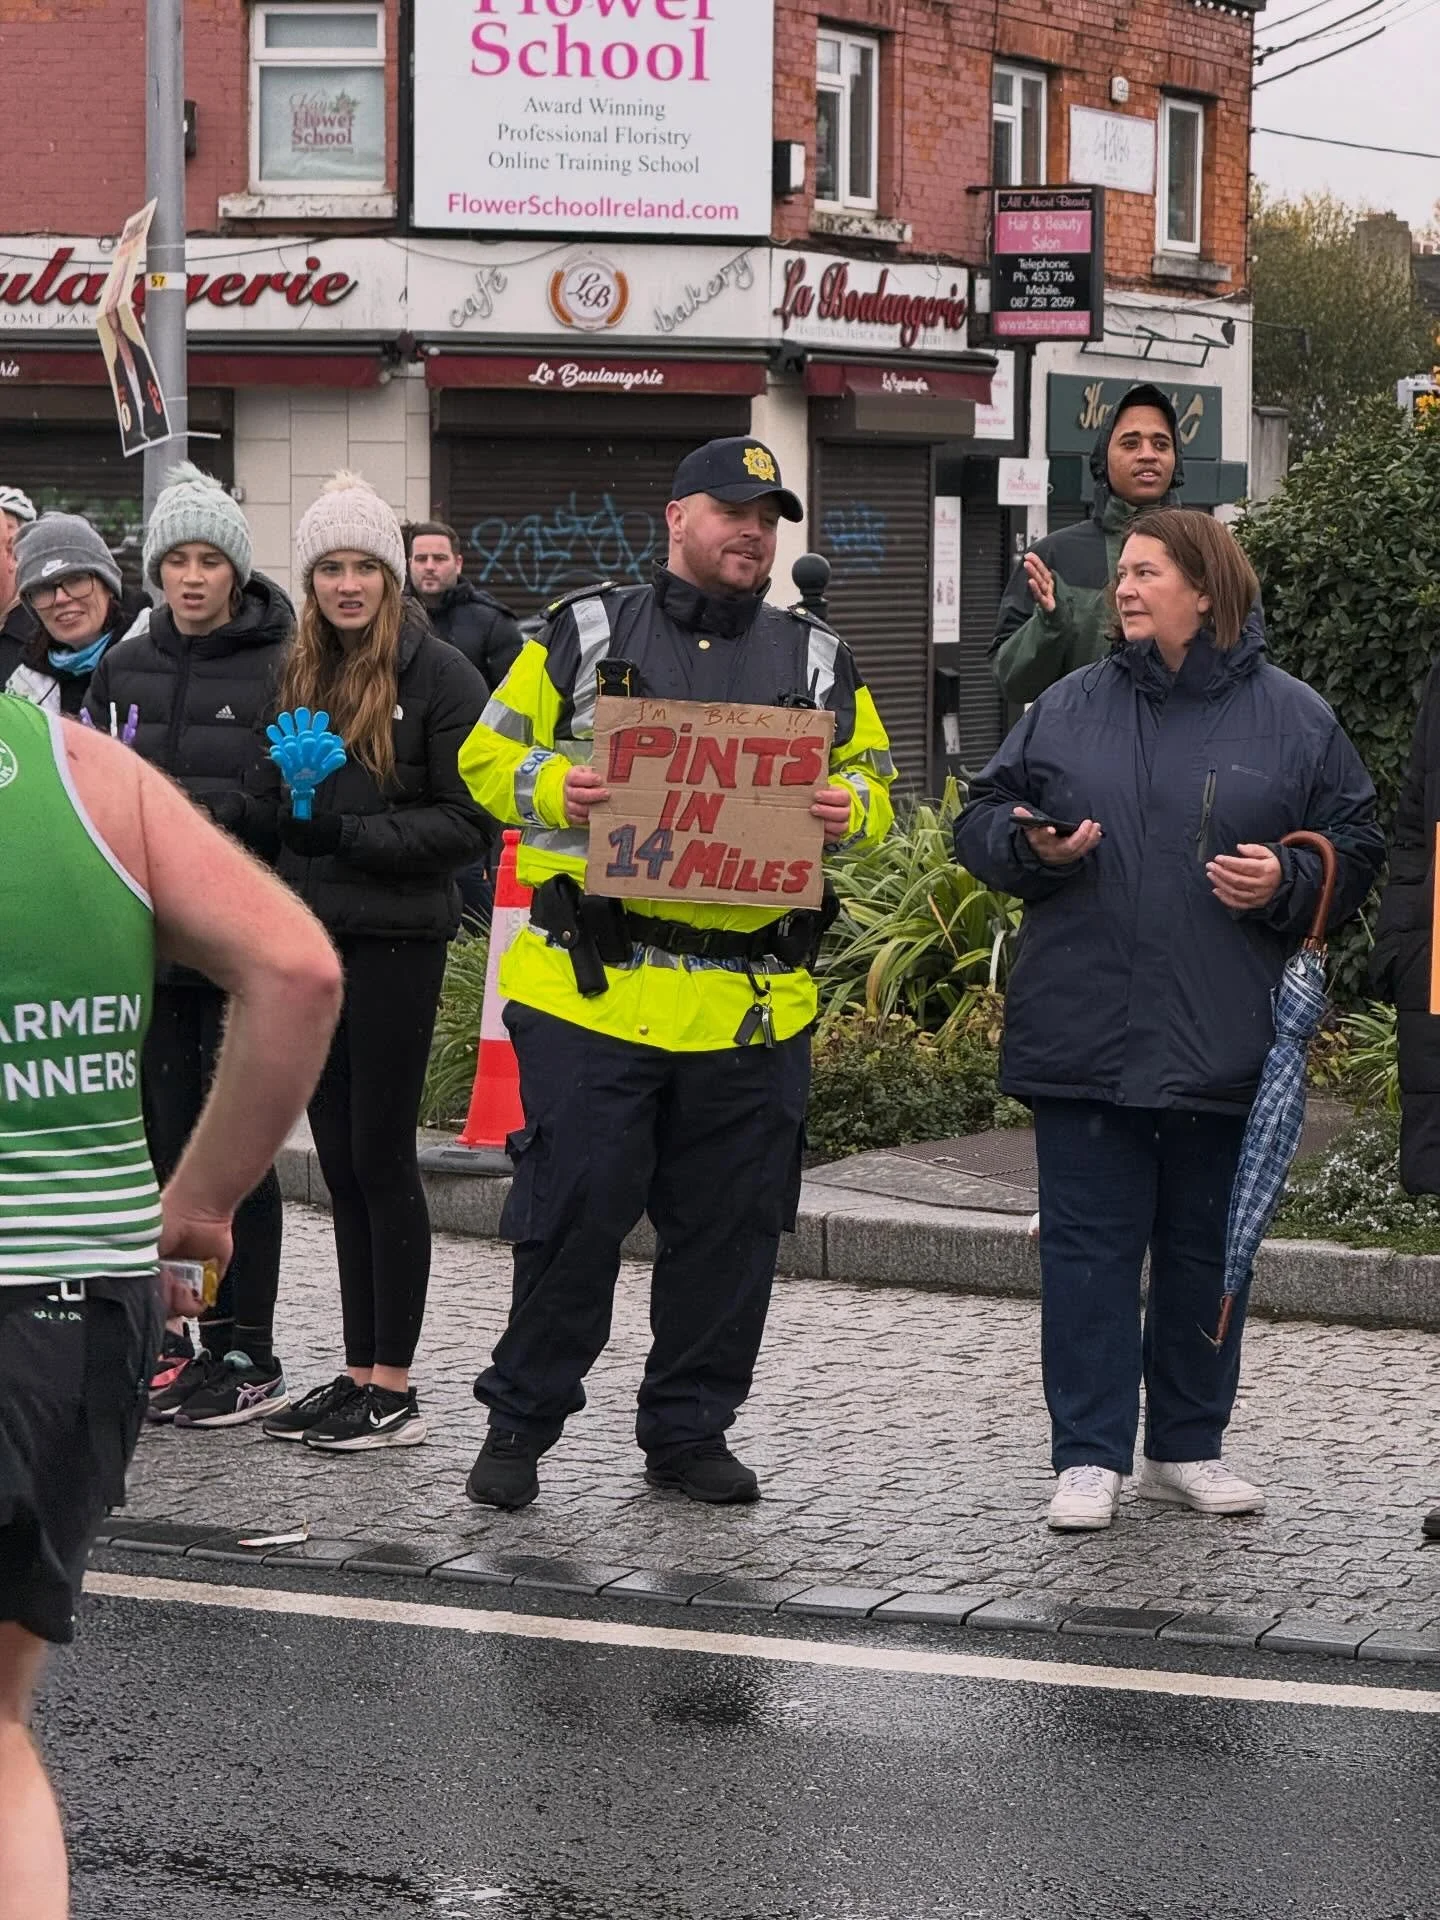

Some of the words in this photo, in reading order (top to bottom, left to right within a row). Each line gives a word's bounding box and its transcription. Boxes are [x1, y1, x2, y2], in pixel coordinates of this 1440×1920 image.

[470, 21, 711, 81] School
[524, 97, 583, 114] Award
[589, 98, 666, 120] Winning
[292, 127, 352, 145] School
[498, 123, 608, 143] Professional
[615, 126, 692, 149] Floristry
[488, 151, 550, 170] Online
[556, 153, 632, 176] Training
[638, 155, 700, 173] School
[448, 193, 739, 220] FlowerSchoolIreland.com
[1001, 196, 1022, 208] All
[1024, 195, 1054, 208] About
[1056, 195, 1090, 209] Beauty
[1008, 215, 1028, 231] Hair
[1032, 215, 1041, 231] &
[1045, 215, 1083, 233] Beauty
[1032, 235, 1061, 250] Salon
[151, 275, 166, 287] 57
[1031, 271, 1050, 282] 453
[1053, 271, 1075, 282] 7316
[450, 265, 508, 328] café
[654, 252, 755, 333] bakery
[773, 258, 816, 331] La
[1010, 297, 1029, 309] 087
[57, 313, 91, 324] BAK
[529, 362, 555, 386] La
[558, 362, 664, 391] Boulangerie
[637, 700, 667, 723] I'M
[703, 709, 774, 728] BACK
[658, 790, 725, 834] IN
[606, 823, 674, 880] 14
[0, 1049, 137, 1101] NNERS
